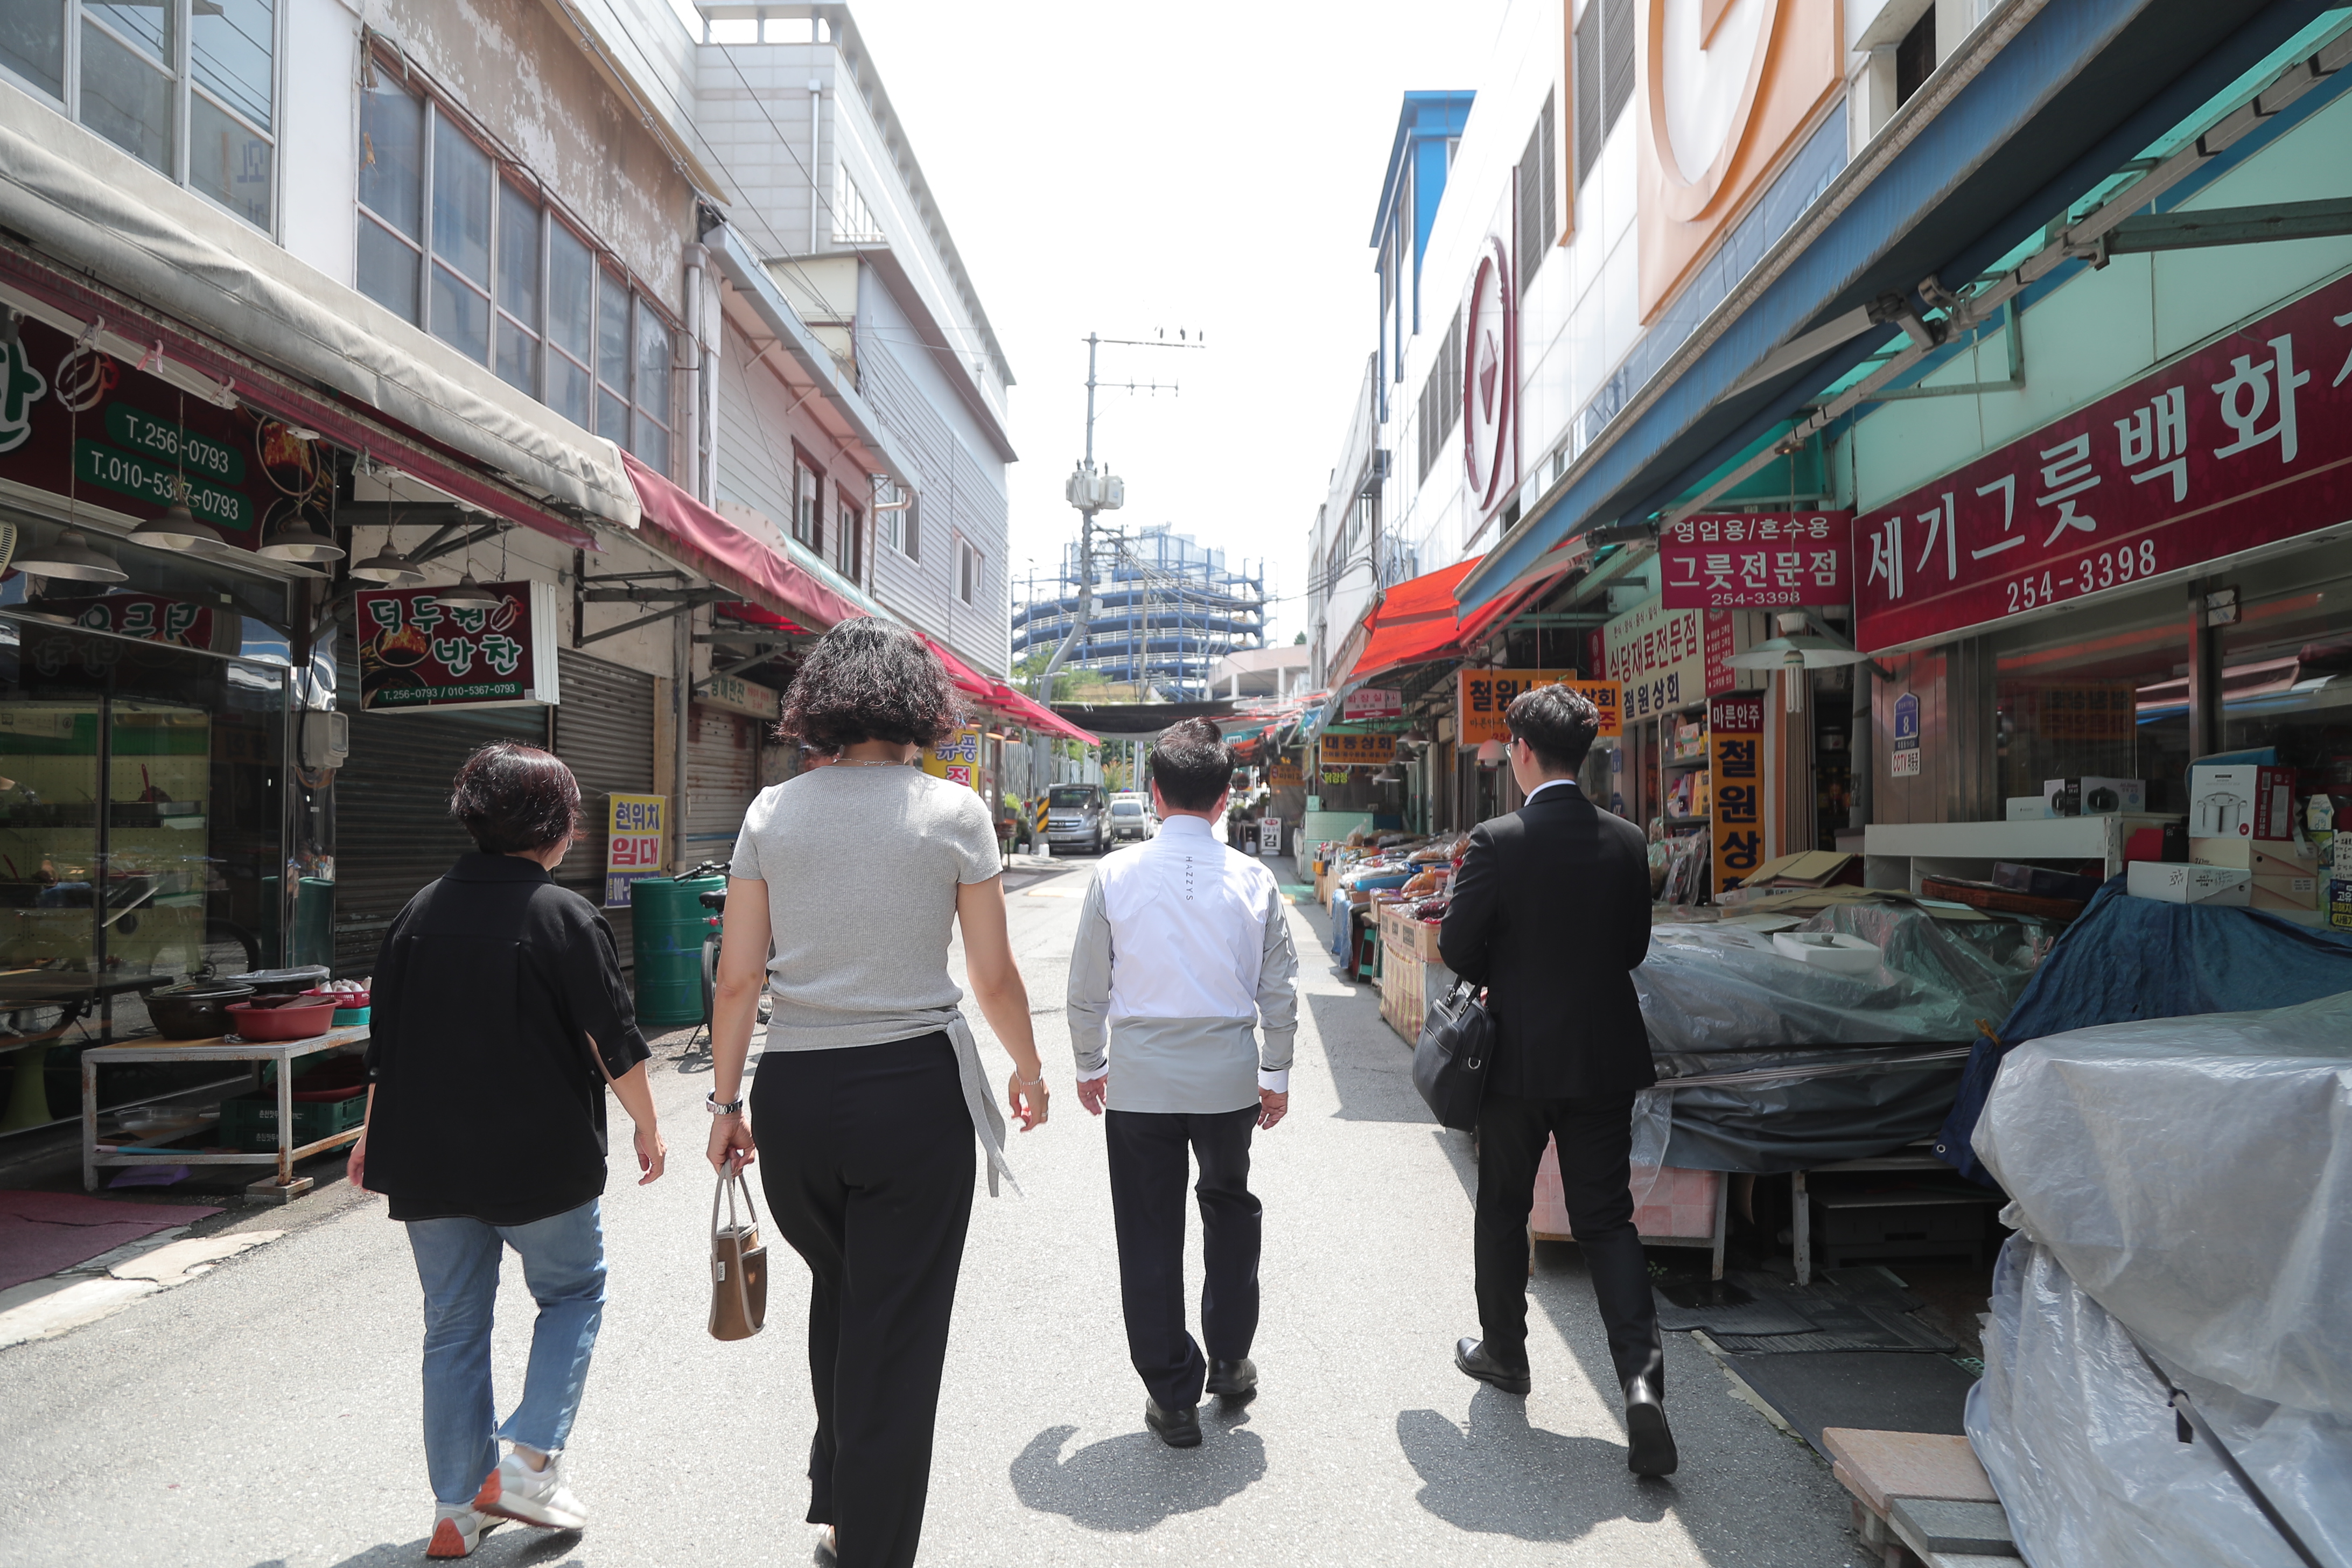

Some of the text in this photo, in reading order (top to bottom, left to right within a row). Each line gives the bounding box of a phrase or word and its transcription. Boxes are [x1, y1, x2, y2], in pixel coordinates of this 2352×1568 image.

[126, 415, 228, 473] T.256-0793
[1867, 315, 2351, 600] 세기그릇백화
[92, 451, 239, 520] T.010-537-0793
[1675, 517, 1830, 543] 영업용/혼수용
[1669, 549, 1837, 590] 그릇전문점
[2007, 538, 2156, 615] 254-3398
[1711, 591, 1800, 606] 254-3398
[432, 634, 523, 677] 반찬
[1610, 608, 1698, 683] 식당재료전문점
[383, 688, 437, 700] T.256-0793
[448, 683, 515, 696] 010-5367-0793
[1470, 679, 1532, 712] 철원
[1623, 671, 1680, 719] 철원상회
[1713, 704, 1760, 729] 마른안주
[1903, 715, 1909, 734] 8
[1893, 754, 1907, 772] CCTV
[615, 801, 660, 830] 현위치
[612, 837, 658, 865] 임대
[1263, 834, 1277, 847] 김
